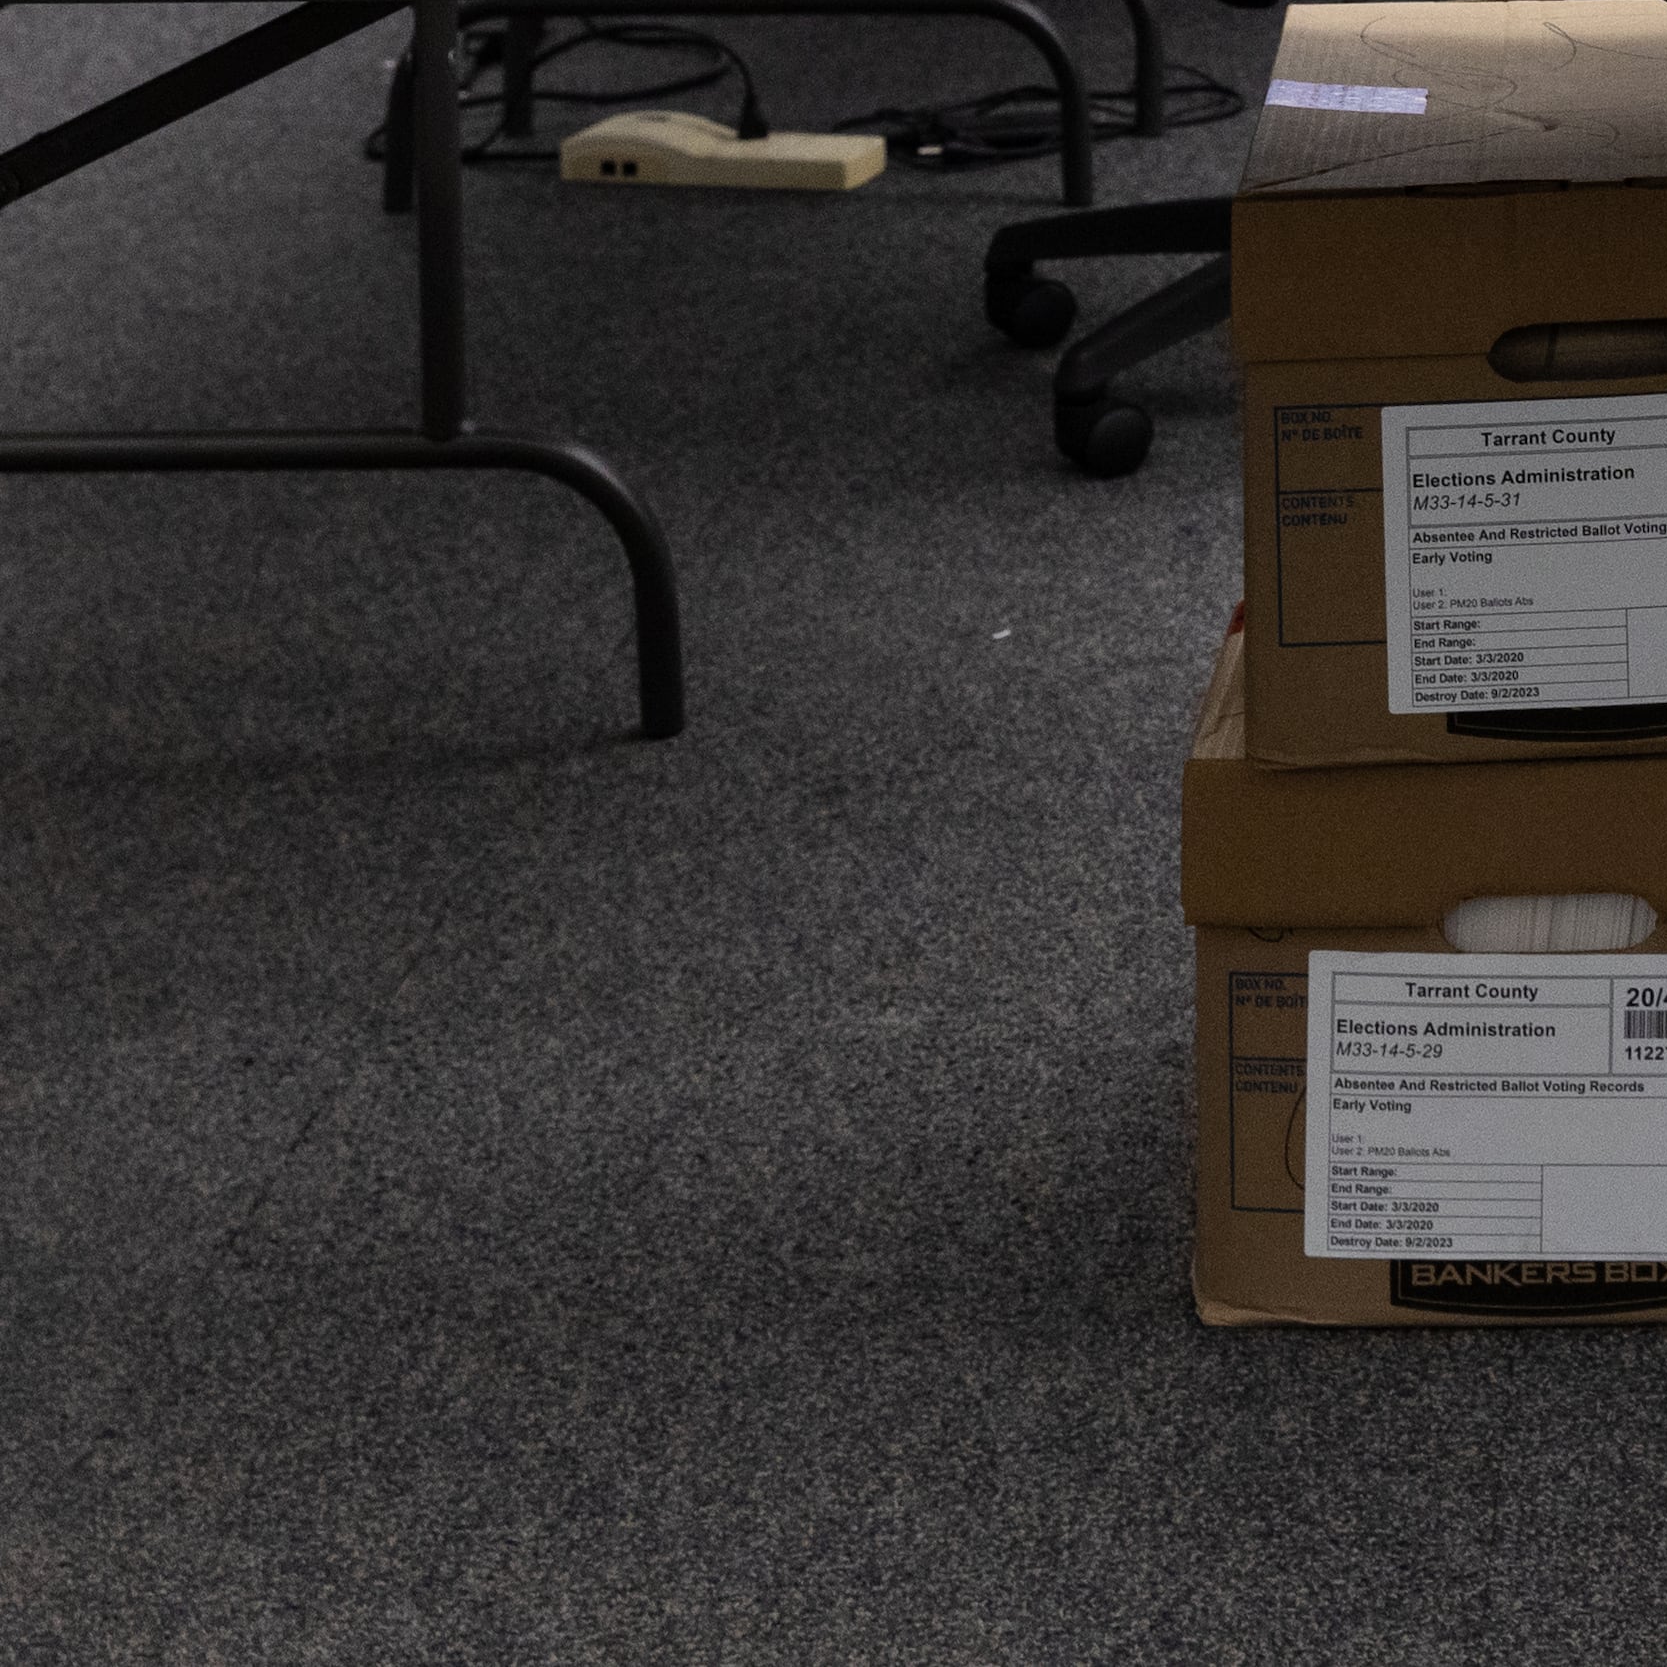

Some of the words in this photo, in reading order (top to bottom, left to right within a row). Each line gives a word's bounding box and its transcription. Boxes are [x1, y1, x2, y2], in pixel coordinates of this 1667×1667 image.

[1281, 412, 1307, 424] BOX
[1302, 428, 1320, 440] DE
[1482, 430, 1546, 447] Tarrant
[1552, 428, 1616, 445] County
[1412, 472, 1496, 489] Elections
[1501, 466, 1635, 486] Administration
[1281, 495, 1355, 510] CONTENTS
[1413, 492, 1521, 510] M33-14-5-31
[1282, 513, 1348, 527] CONTENU
[1412, 530, 1475, 544] Absentee
[1478, 528, 1506, 540] And
[1509, 525, 1578, 540] Restricted
[1582, 523, 1621, 537] Ballot
[1624, 521, 1667, 536] Voting
[1412, 552, 1445, 566] Early
[1449, 550, 1492, 564] Voting
[1413, 588, 1434, 598] User
[1413, 599, 1434, 610] User
[1450, 598, 1477, 609] PM20
[1480, 597, 1512, 608] Ballots
[1515, 596, 1534, 606] Abs
[1413, 620, 1440, 631] Start
[1443, 619, 1481, 632] Range:
[1414, 638, 1435, 649] End
[1438, 637, 1476, 650] Range:
[1414, 656, 1441, 666] Start
[1444, 654, 1472, 665] Date:
[1476, 652, 1524, 664] 3/3/2020
[1415, 674, 1436, 684] End
[1439, 673, 1467, 683] Date:
[1471, 670, 1519, 682] 3/3/2020
[1415, 691, 1457, 703] Destroy
[1461, 690, 1488, 700] Date:
[1491, 687, 1540, 699] 9/2/2023
[1405, 982, 1470, 998] Tarrant
[1475, 983, 1539, 1002] County
[1255, 995, 1272, 1007] DE
[1336, 1019, 1418, 1036] Elections
[1423, 1021, 1556, 1037] Administration
[1336, 1041, 1443, 1058] M33-14-5-29
[1235, 1063, 1305, 1076] CONTENTS
[1235, 1081, 1298, 1093] CONTENU
[1334, 1077, 1395, 1090] Absentee
[1398, 1078, 1426, 1091] And
[1429, 1079, 1498, 1092] Restricted
[1501, 1079, 1540, 1092] Ballot
[1543, 1080, 1586, 1094] Voting
[1590, 1081, 1645, 1093] Records
[1333, 1098, 1367, 1112] Early
[1369, 1099, 1412, 1113] Voting
[1332, 1134, 1354, 1143] User
[1332, 1146, 1354, 1156] User
[1368, 1146, 1396, 1156] PM20
[1398, 1147, 1430, 1157] Ballots
[1432, 1147, 1451, 1157] Abs
[1331, 1165, 1358, 1176] Start
[1361, 1166, 1397, 1179] Range:
[1331, 1183, 1352, 1193] End
[1355, 1184, 1392, 1196] Range:
[1331, 1201, 1357, 1211] Start
[1361, 1201, 1387, 1212] Date:
[1392, 1202, 1440, 1212] 3/3/2020
[1330, 1218, 1352, 1228] End
[1355, 1218, 1382, 1229] Date:
[1386, 1219, 1434, 1230] 3/3/2020
[1330, 1236, 1372, 1249] Destroy
[1375, 1236, 1403, 1247] Date:
[1405, 1236, 1453, 1248] 9/2/2023
[1411, 1261, 1596, 1287] BANKERS
